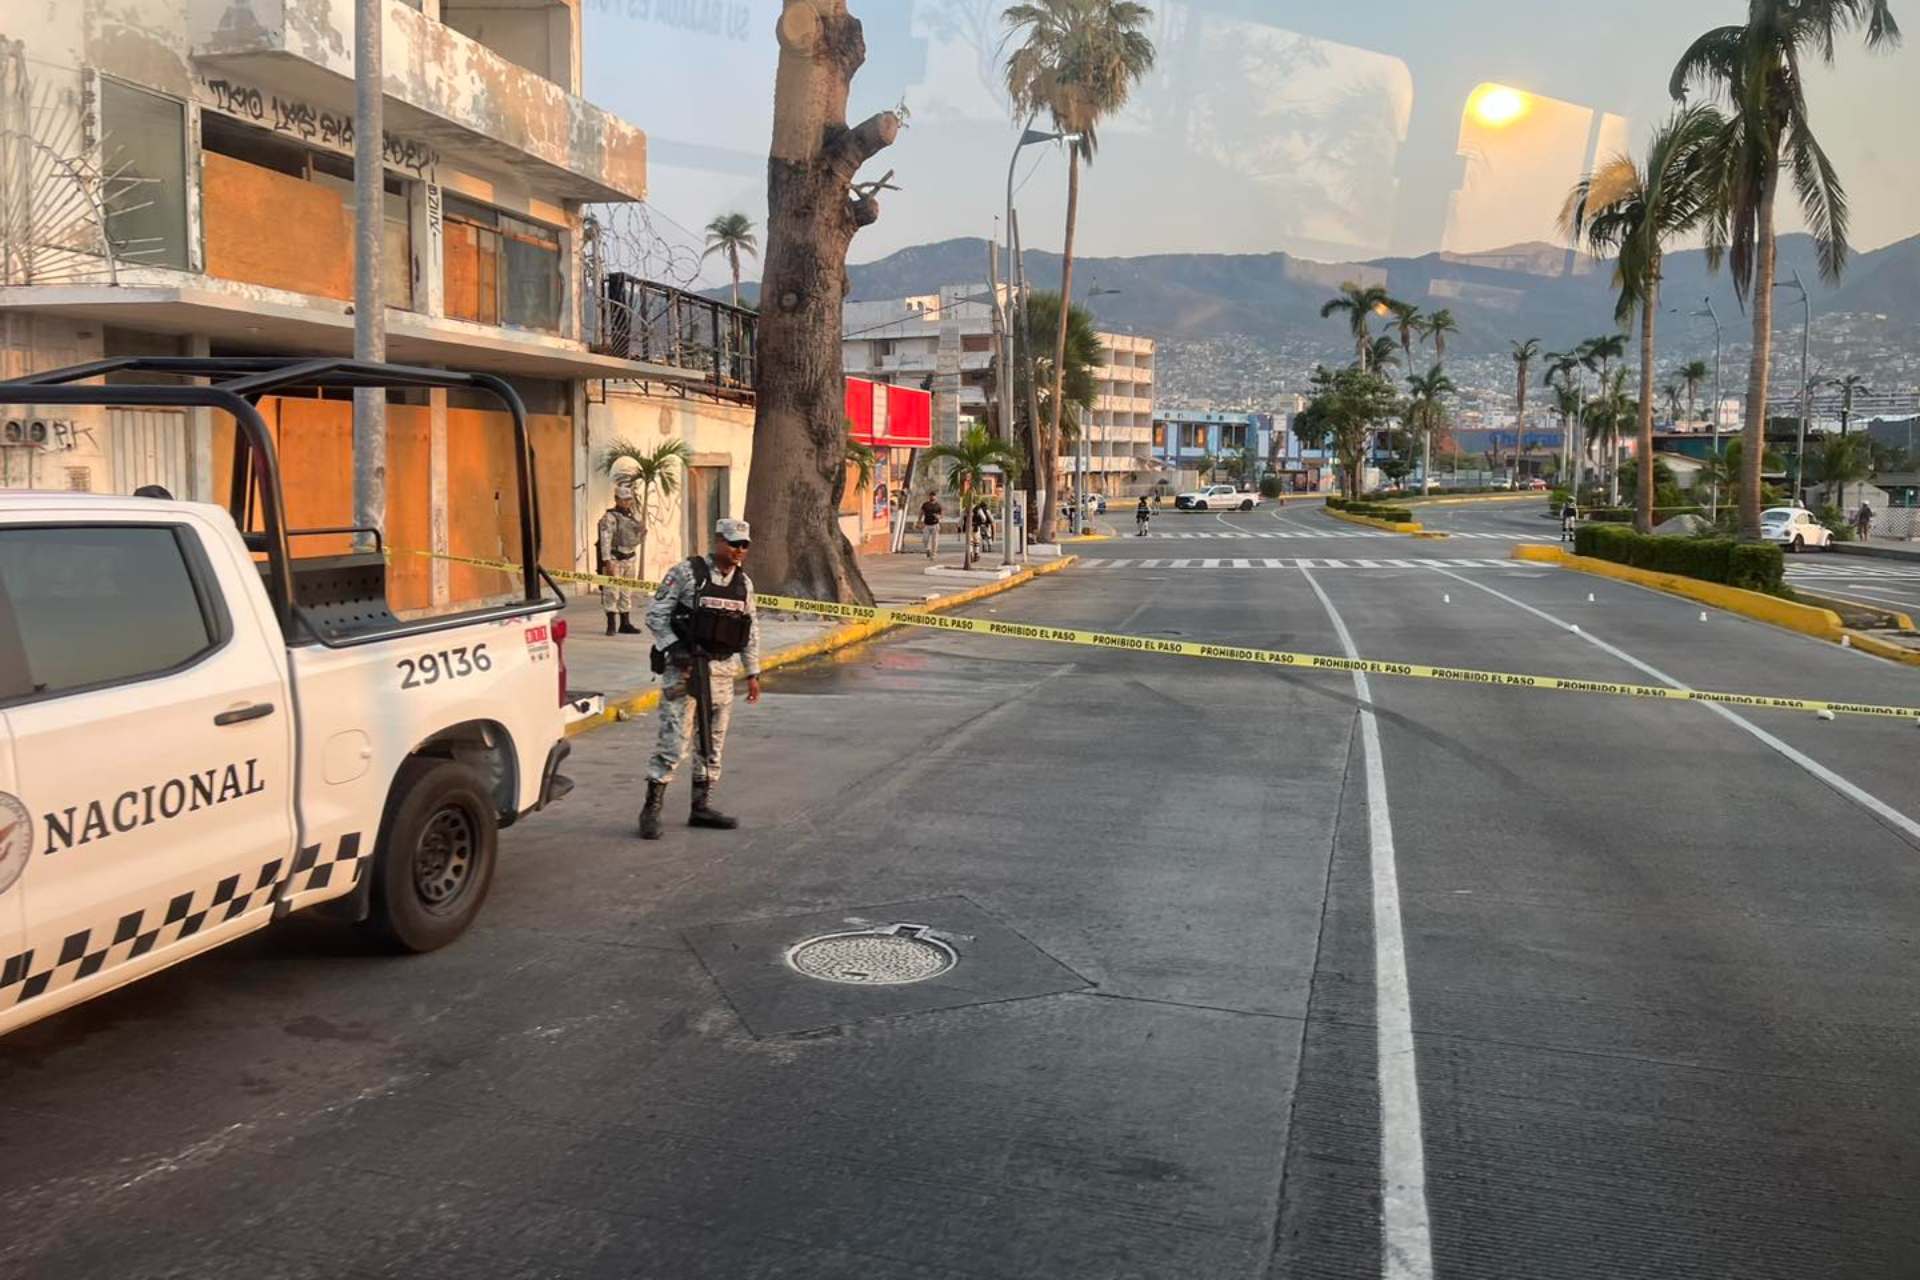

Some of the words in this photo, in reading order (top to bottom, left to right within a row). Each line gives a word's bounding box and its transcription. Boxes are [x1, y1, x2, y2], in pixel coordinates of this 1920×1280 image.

[757, 596, 779, 606] PASO
[794, 601, 838, 614] PROHIBIDO
[841, 606, 850, 616] EL
[853, 608, 875, 618] PASO
[890, 612, 936, 625] PROHIBIDO
[939, 618, 949, 627] EL
[951, 620, 973, 630] PASO
[990, 624, 1037, 637] PROHIBIDO
[1040, 630, 1050, 639] EL
[1052, 631, 1076, 641] PASO
[1093, 635, 1142, 648] PROHIBIDO
[1144, 641, 1155, 650] EL
[1158, 642, 1182, 652] PASO
[1200, 646, 1252, 659] PROHIBIDO
[1255, 652, 1266, 661] EL
[1269, 653, 1294, 663] PASO
[396, 643, 492, 690] 29136
[1313, 657, 1367, 671] PROHIBIDO
[1370, 662, 1382, 672] EL
[1385, 664, 1411, 674] PASO
[1432, 669, 1488, 681] PROHIBIDO
[1491, 674, 1503, 683] EL
[1507, 676, 1535, 685] PASO
[1557, 680, 1616, 693] PROHIBIDO
[1637, 688, 1667, 697] PASO
[43, 758, 265, 855] NACIONAL
